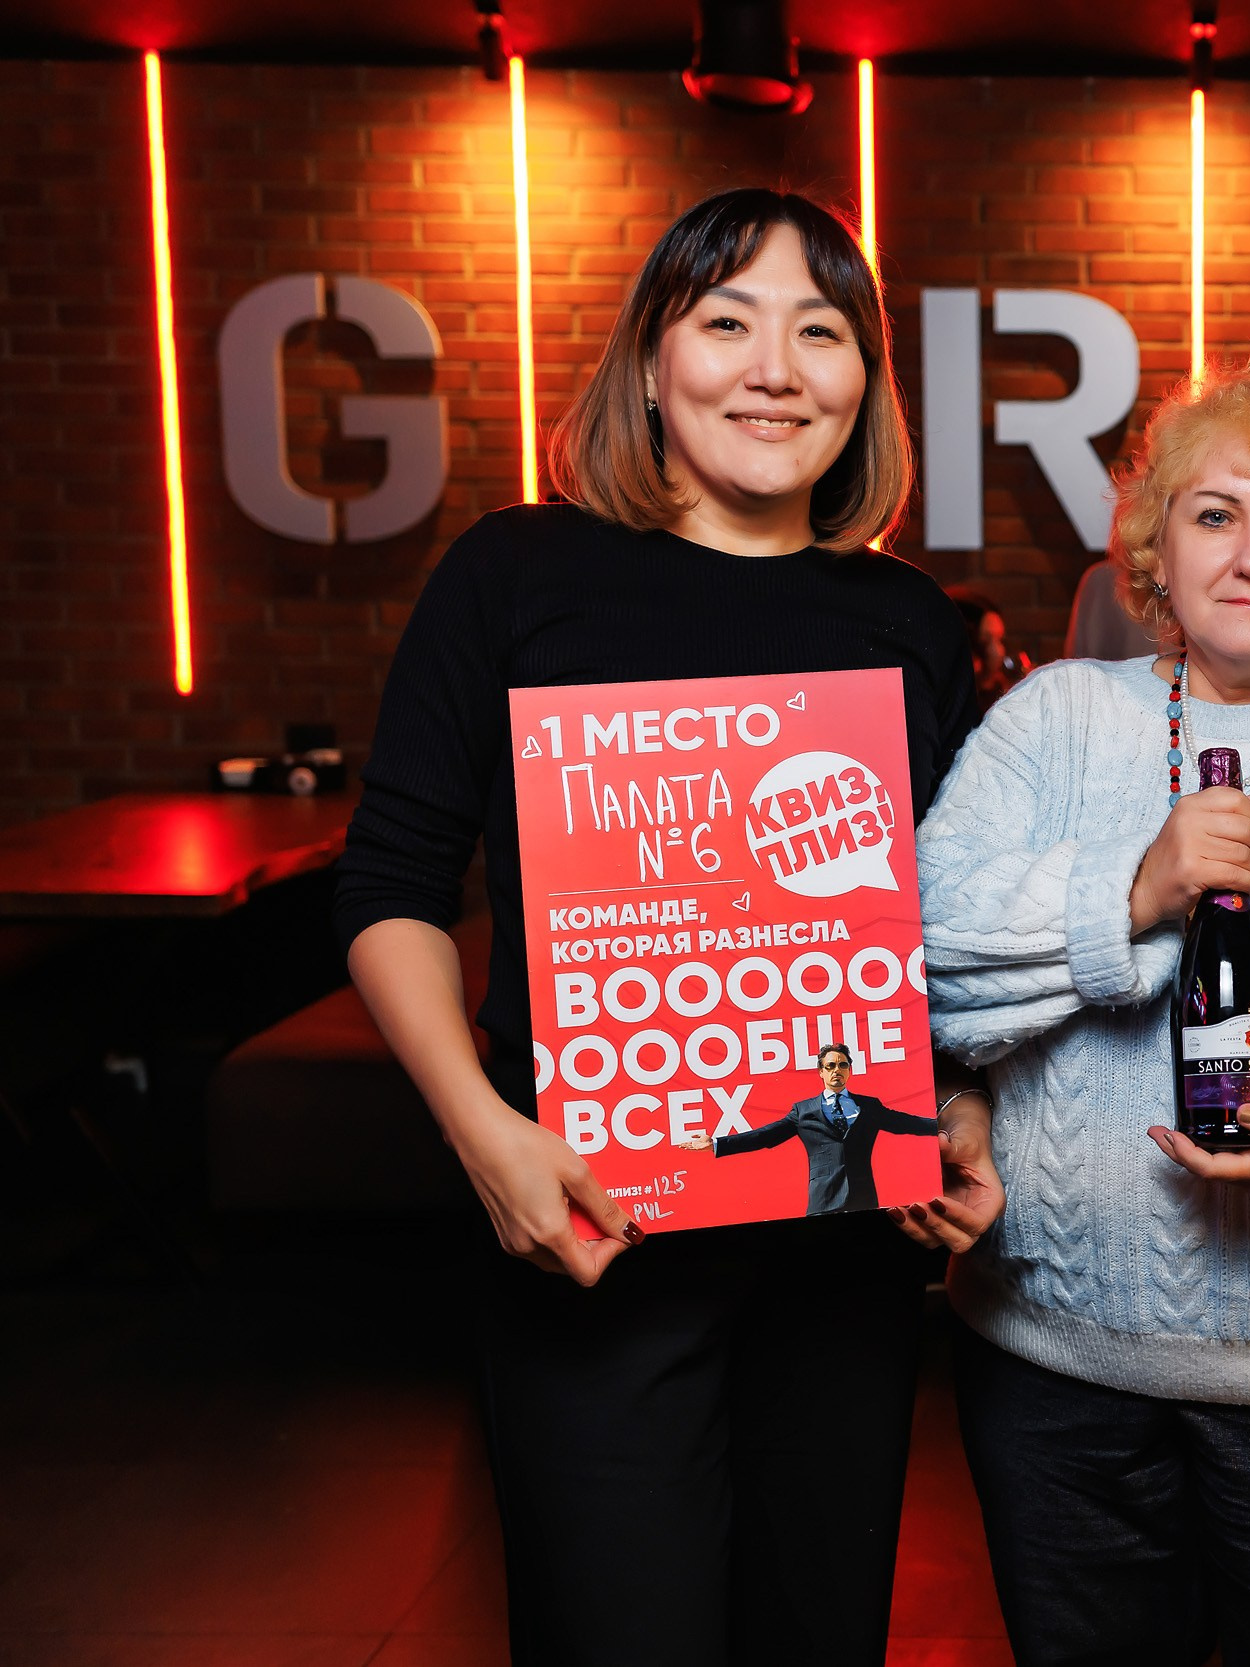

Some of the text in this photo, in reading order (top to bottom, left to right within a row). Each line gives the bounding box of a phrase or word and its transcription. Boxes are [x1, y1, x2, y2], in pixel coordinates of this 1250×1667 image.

[540, 703, 781, 758] 1 МЕСТО
[747, 767, 890, 840] КВИЗ,
[755, 803, 897, 880] ПЛИЗ!
[549, 897, 708, 931] КОМАНДЕ,
[551, 919, 851, 964] КОТОРАЯ РАЗНЕСЛА
[1198, 1058, 1243, 1073] SANTO
[563, 1083, 754, 1155] ВСЕХ
